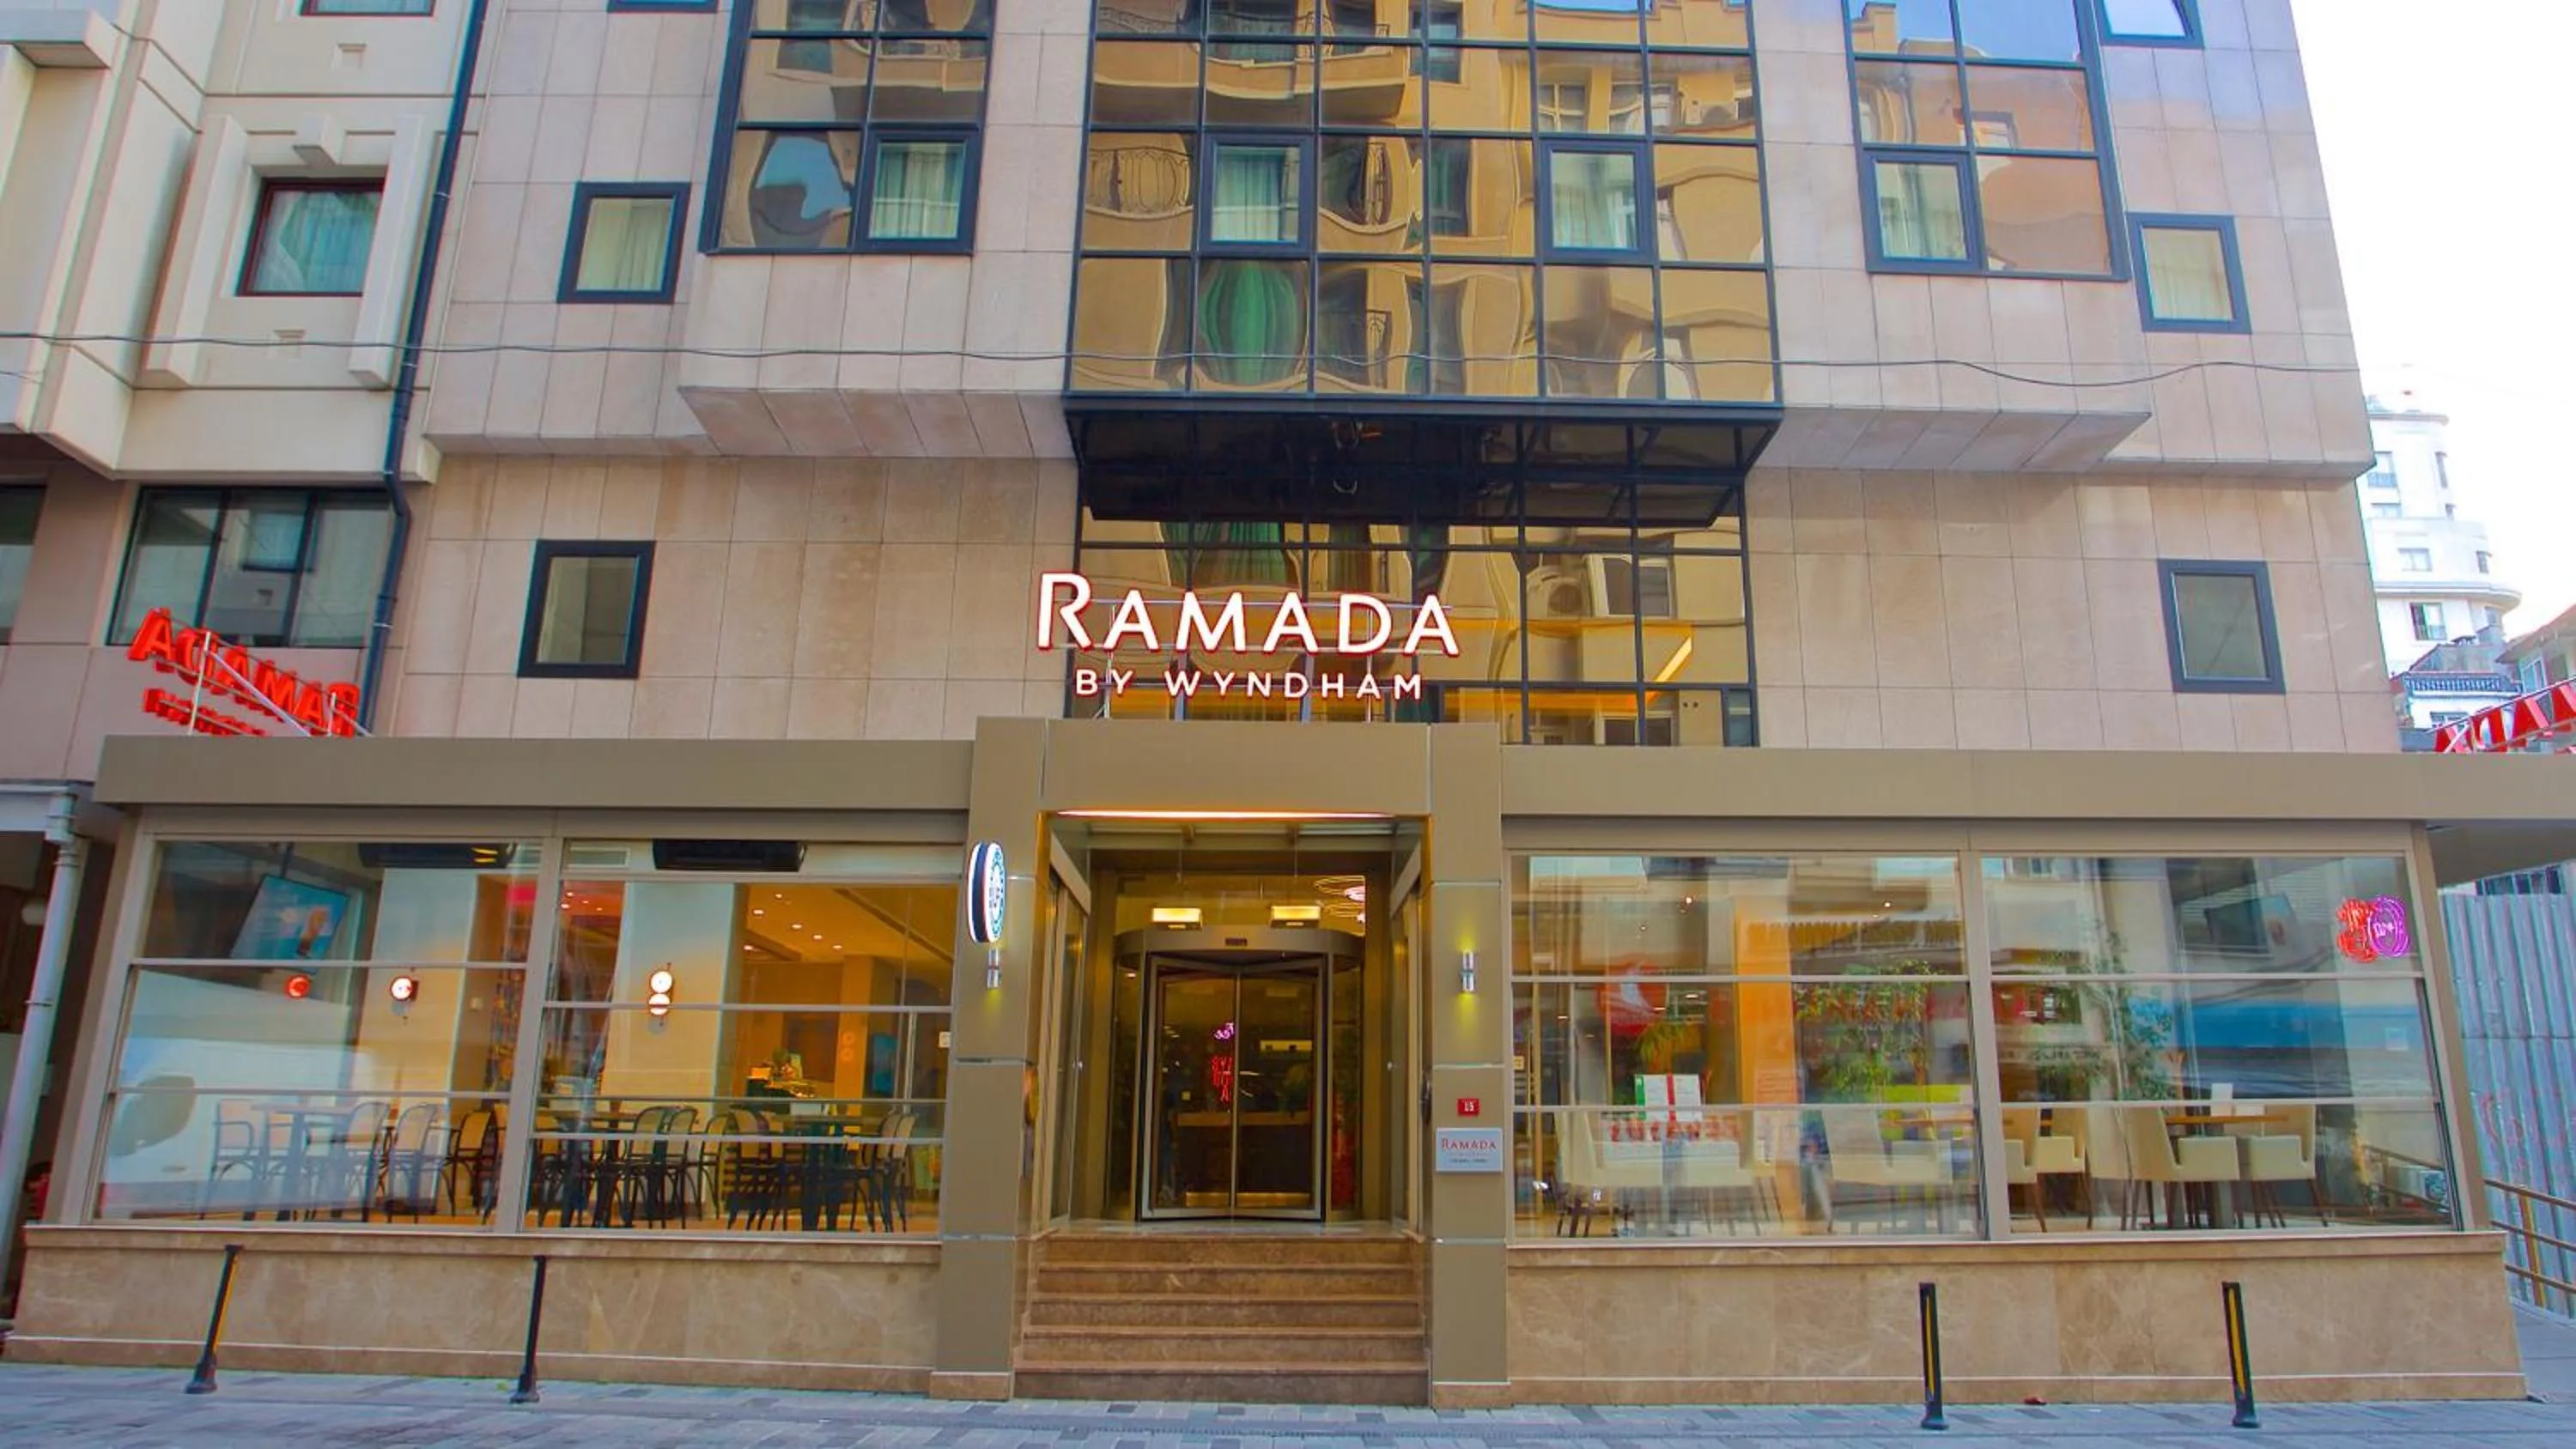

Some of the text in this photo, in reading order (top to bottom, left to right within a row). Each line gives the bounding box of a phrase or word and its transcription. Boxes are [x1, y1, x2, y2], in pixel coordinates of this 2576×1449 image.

[1037, 572, 1459, 657] RAMADA
[1075, 669, 1422, 700] BY WYNDHAM
[1442, 1138, 1498, 1150] RAMADA
